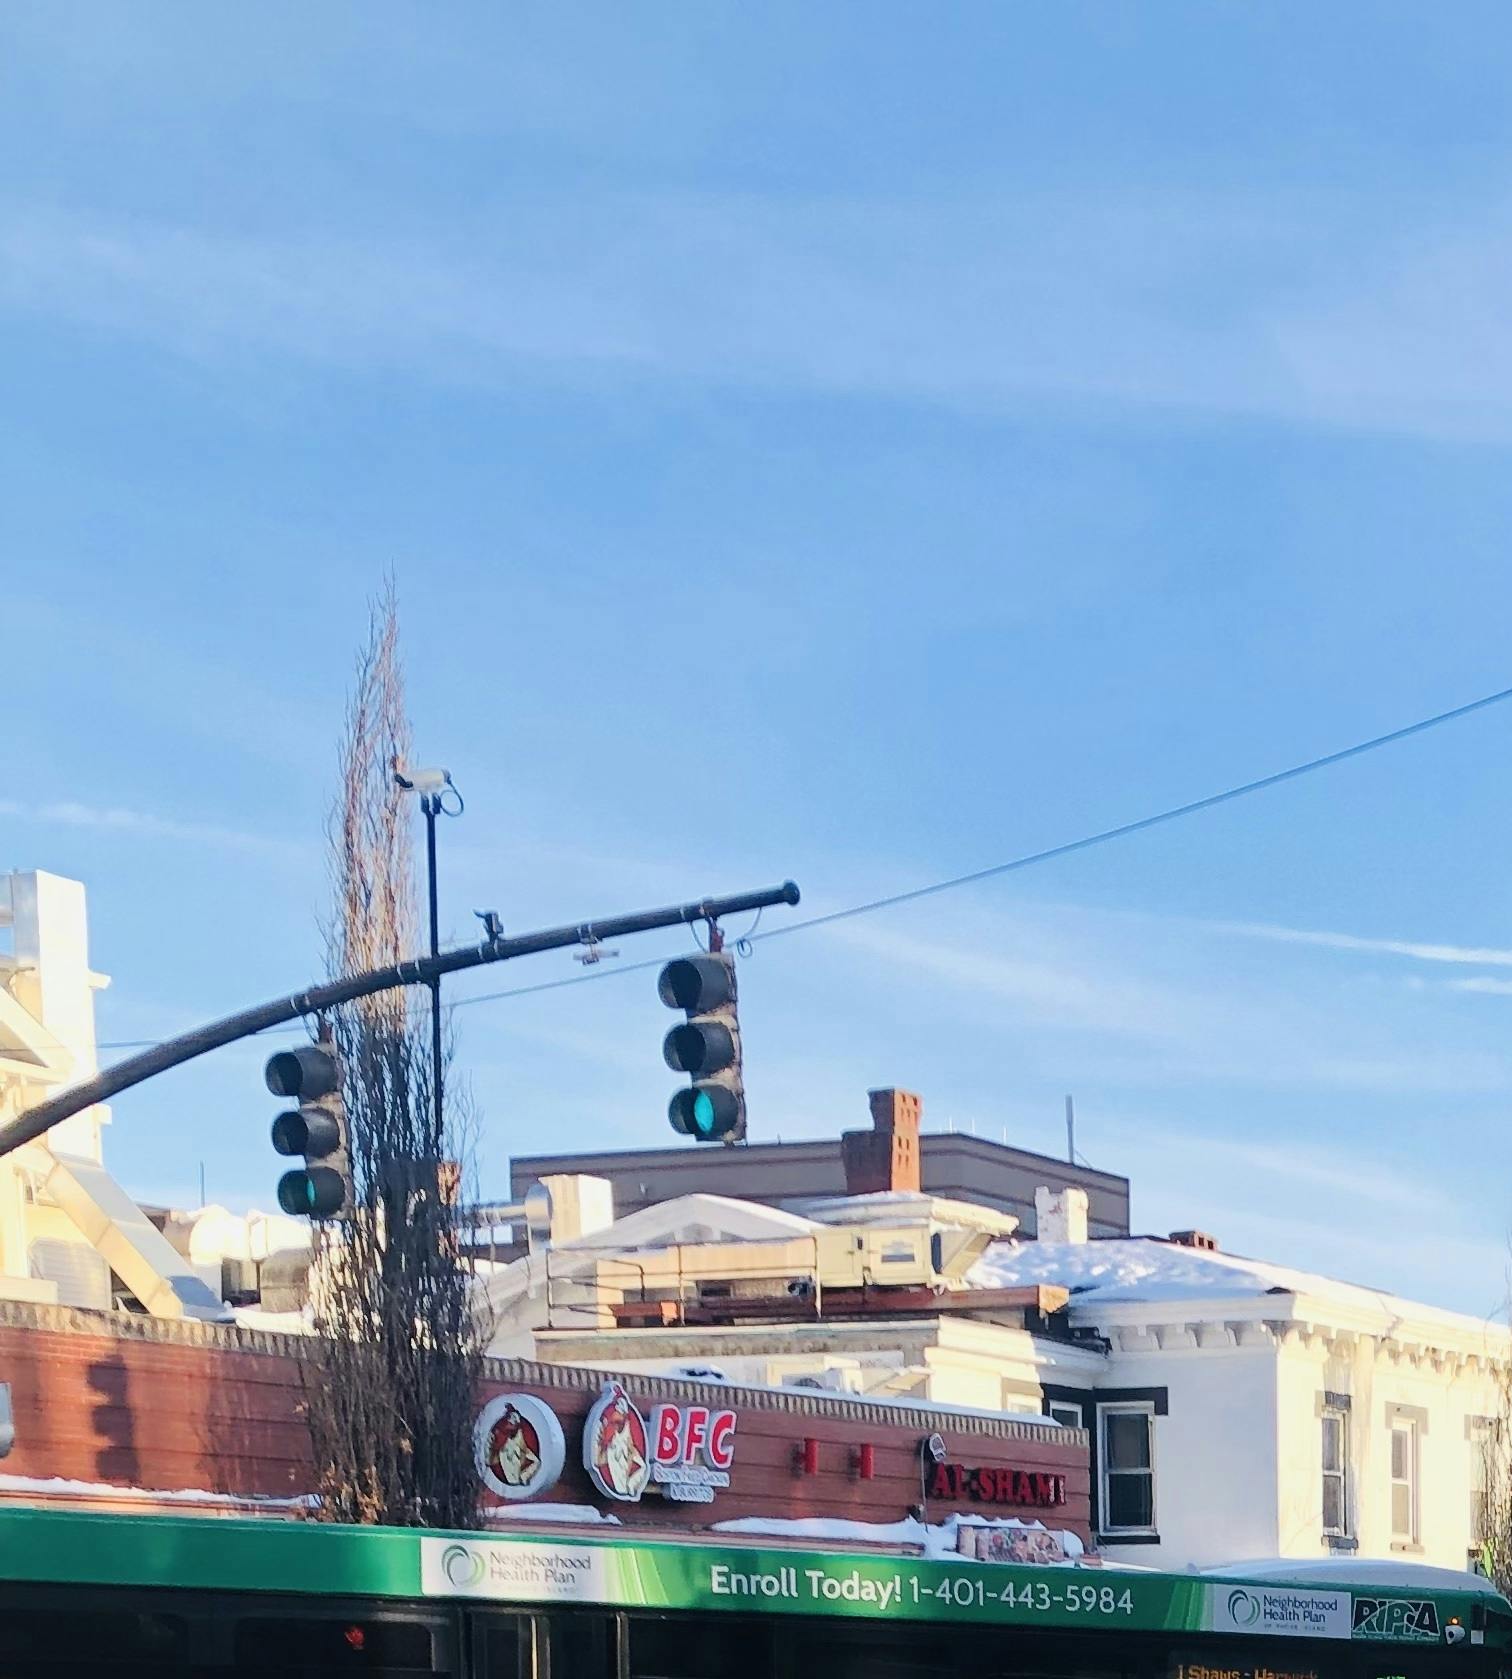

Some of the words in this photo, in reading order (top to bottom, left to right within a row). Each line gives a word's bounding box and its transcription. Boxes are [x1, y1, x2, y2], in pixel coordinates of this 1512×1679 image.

[655, 1405, 736, 1467] BFC
[490, 1550, 592, 1570] Neighborhood
[490, 1566, 540, 1582] Health
[544, 1568, 576, 1584] Plan
[710, 1565, 798, 1598] Enroll
[805, 1569, 901, 1609] Today!
[909, 1577, 1134, 1614] 1-401-443-5984
[1264, 1594, 1337, 1611] Neighborhood
[1264, 1608, 1300, 1621] Health
[1303, 1610, 1326, 1622] Plan
